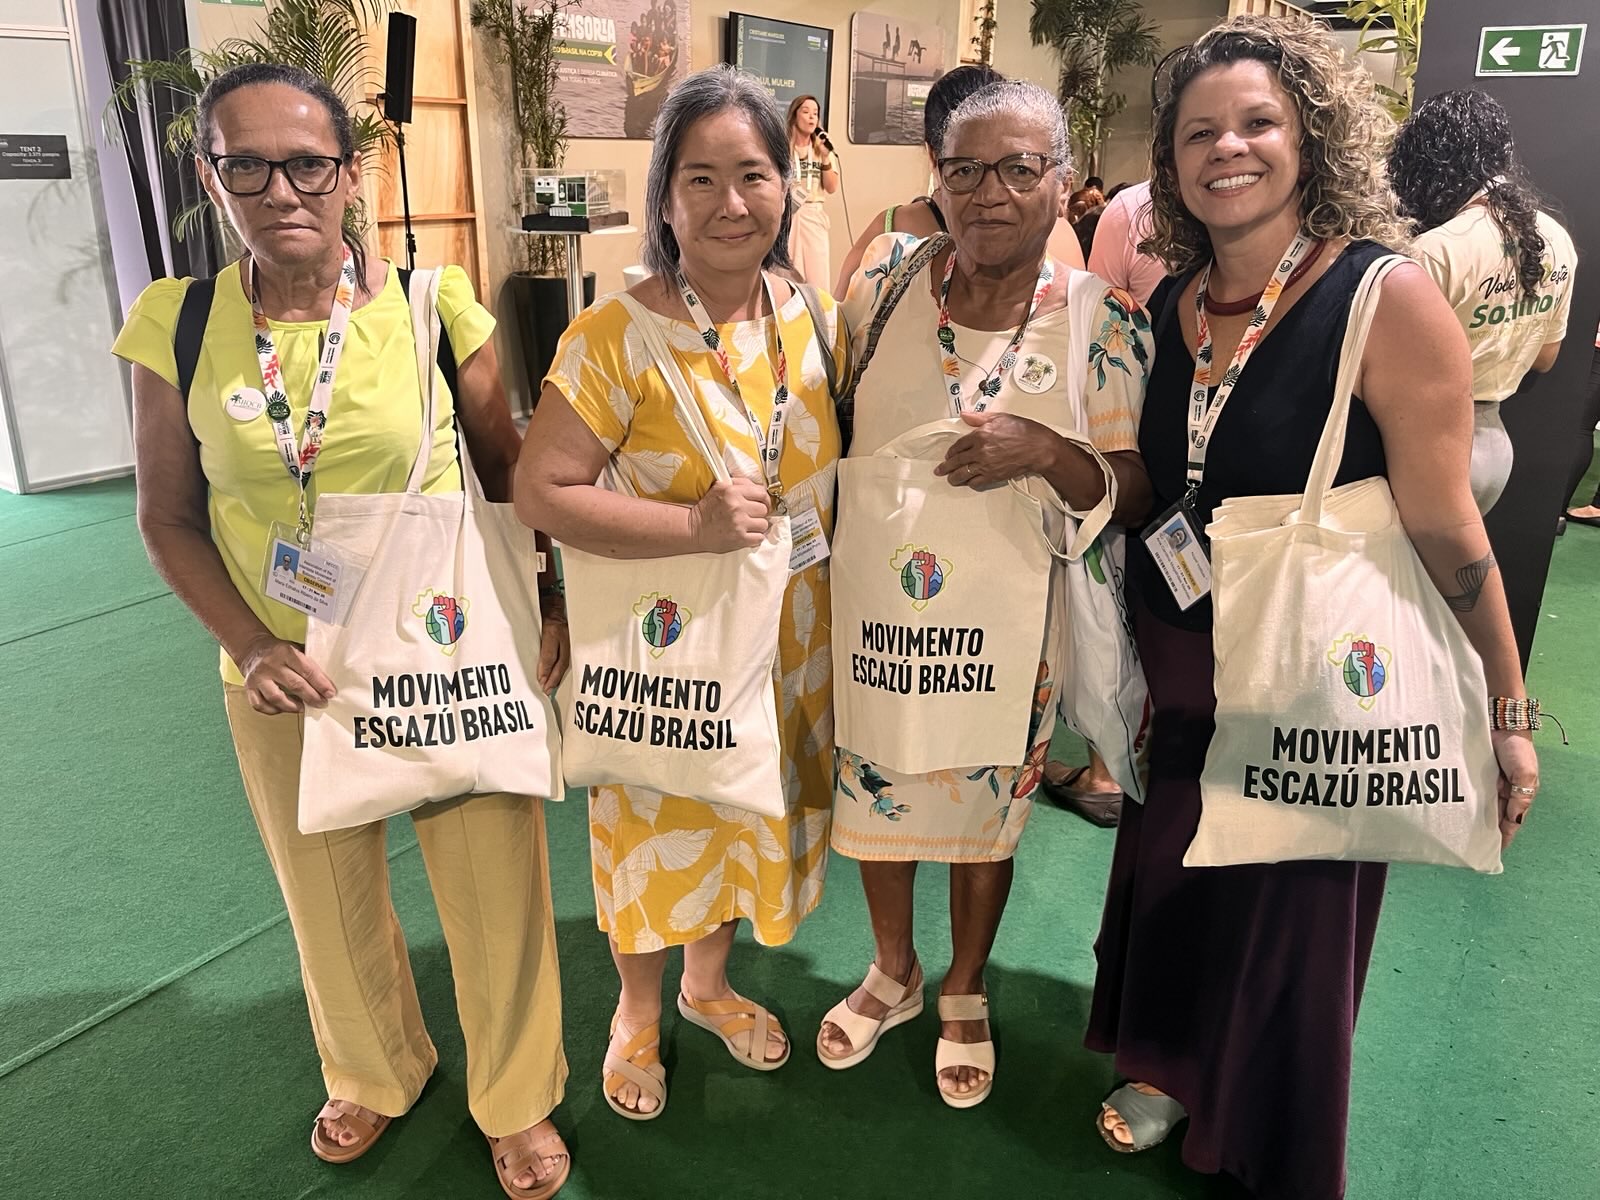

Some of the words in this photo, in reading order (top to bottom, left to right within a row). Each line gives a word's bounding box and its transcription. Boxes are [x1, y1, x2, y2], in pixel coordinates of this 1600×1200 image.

[771, 77, 795, 88] MULHER
[1478, 273, 1516, 300] Você
[862, 619, 984, 657] MOVIMENTO
[372, 663, 511, 709] MOVIMENTO
[580, 664, 722, 713] MOVIMENTO
[852, 653, 912, 695] ESCAZÚ
[918, 663, 996, 695] BRASIL
[353, 707, 456, 749] ESCAZÚ
[460, 700, 535, 742] BRASIL
[574, 700, 645, 743] SCAZÚ
[650, 714, 737, 751] BRASIL
[1272, 723, 1441, 765] MOVIMENTO
[1243, 764, 1359, 808] ESCAZÚ
[1365, 768, 1465, 807] BRASIL
